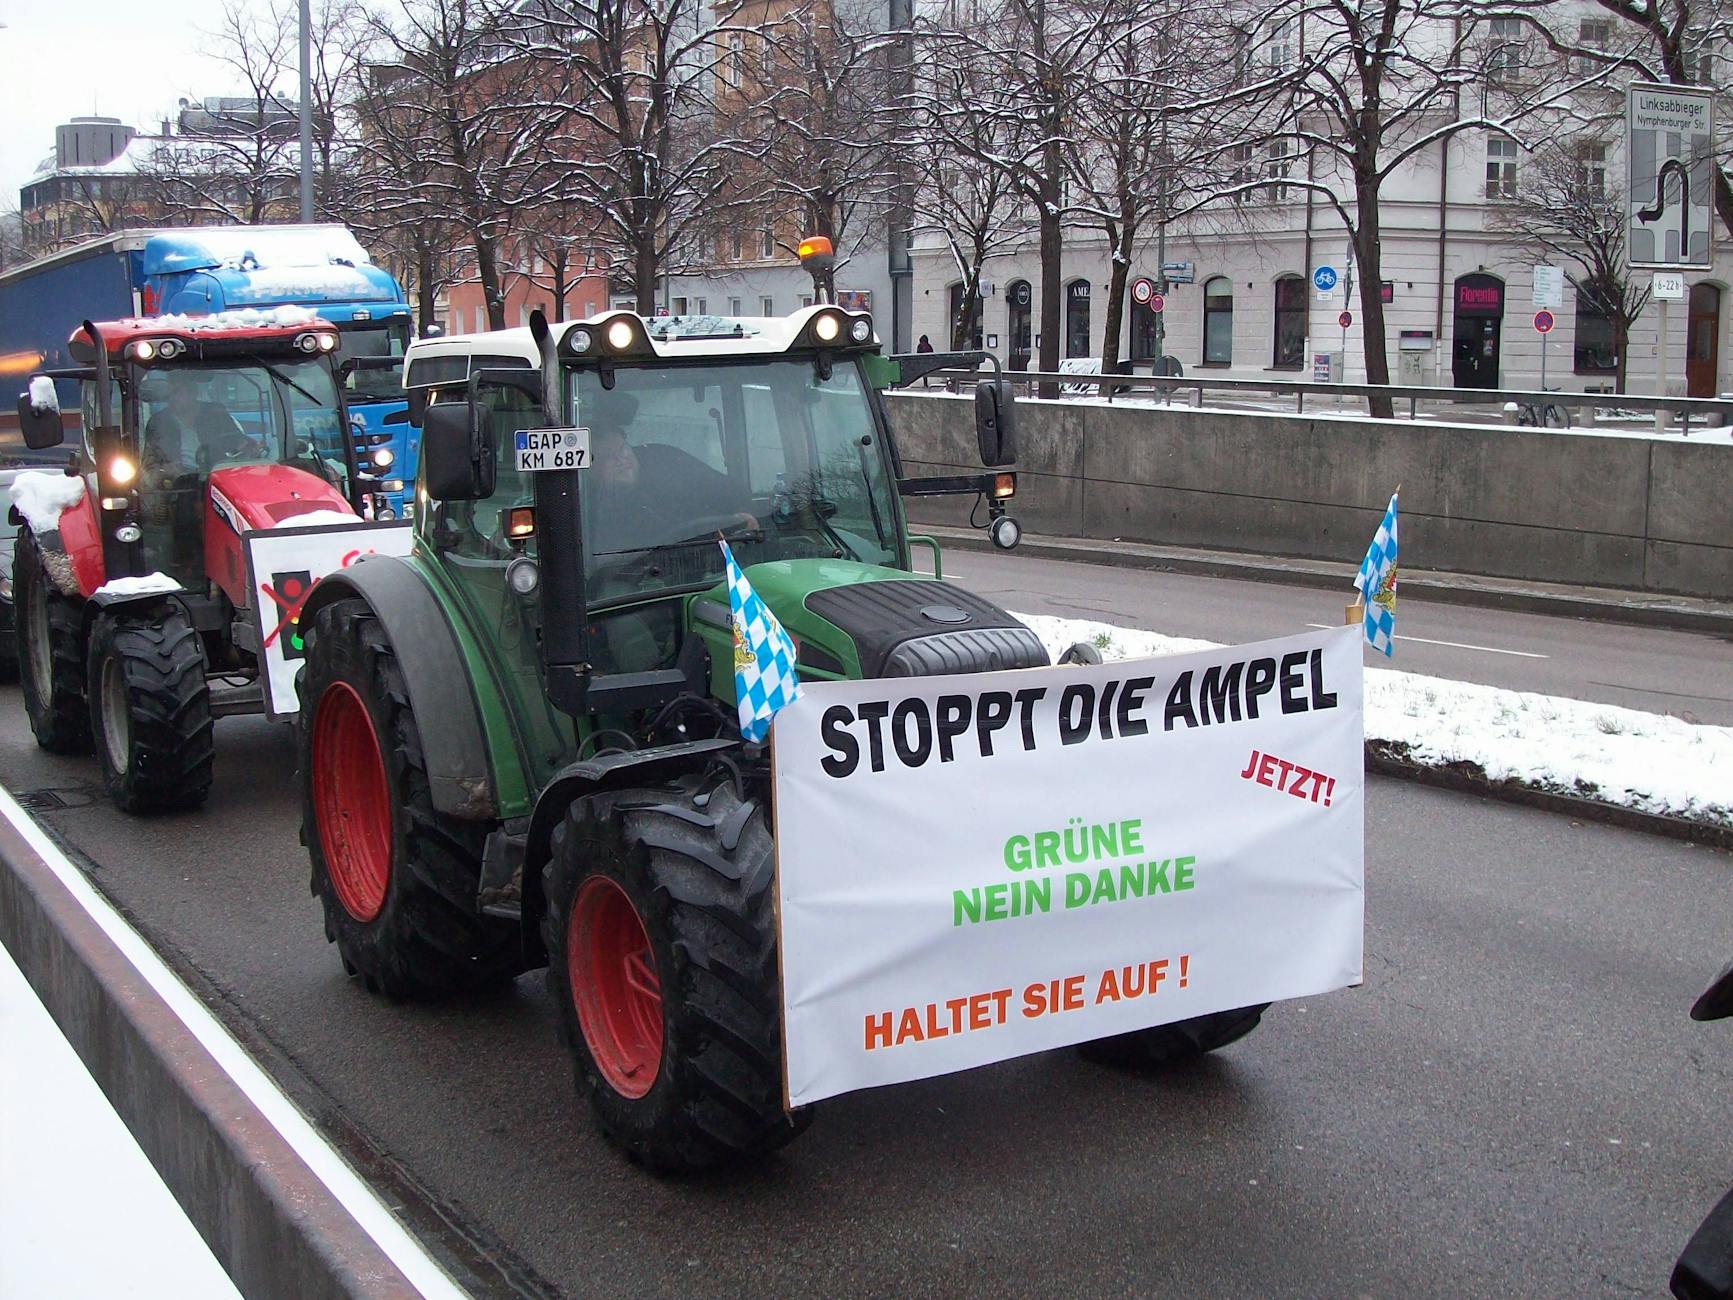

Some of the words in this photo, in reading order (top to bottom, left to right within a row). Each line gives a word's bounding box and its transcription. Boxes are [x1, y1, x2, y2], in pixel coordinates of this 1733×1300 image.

[1638, 113, 1691, 130] Nymphenburger
[1694, 119, 1706, 130] Str.
[1640, 96, 1704, 117] Linksabbieger
[521, 451, 545, 469] KM
[554, 450, 585, 468] 687
[528, 433, 562, 450] GAP
[820, 687, 1048, 778] STOPPT
[1058, 676, 1156, 746] DIE
[1163, 648, 1338, 732] AMPEL
[1240, 750, 1337, 807] JETZT!
[1003, 817, 1145, 873] GRÜNE
[952, 878, 1052, 927] NEIN
[1064, 855, 1196, 909] DANKE
[864, 988, 1013, 1051] HALTET
[1023, 975, 1086, 1019] SIE
[1095, 959, 1169, 1005] AUF
